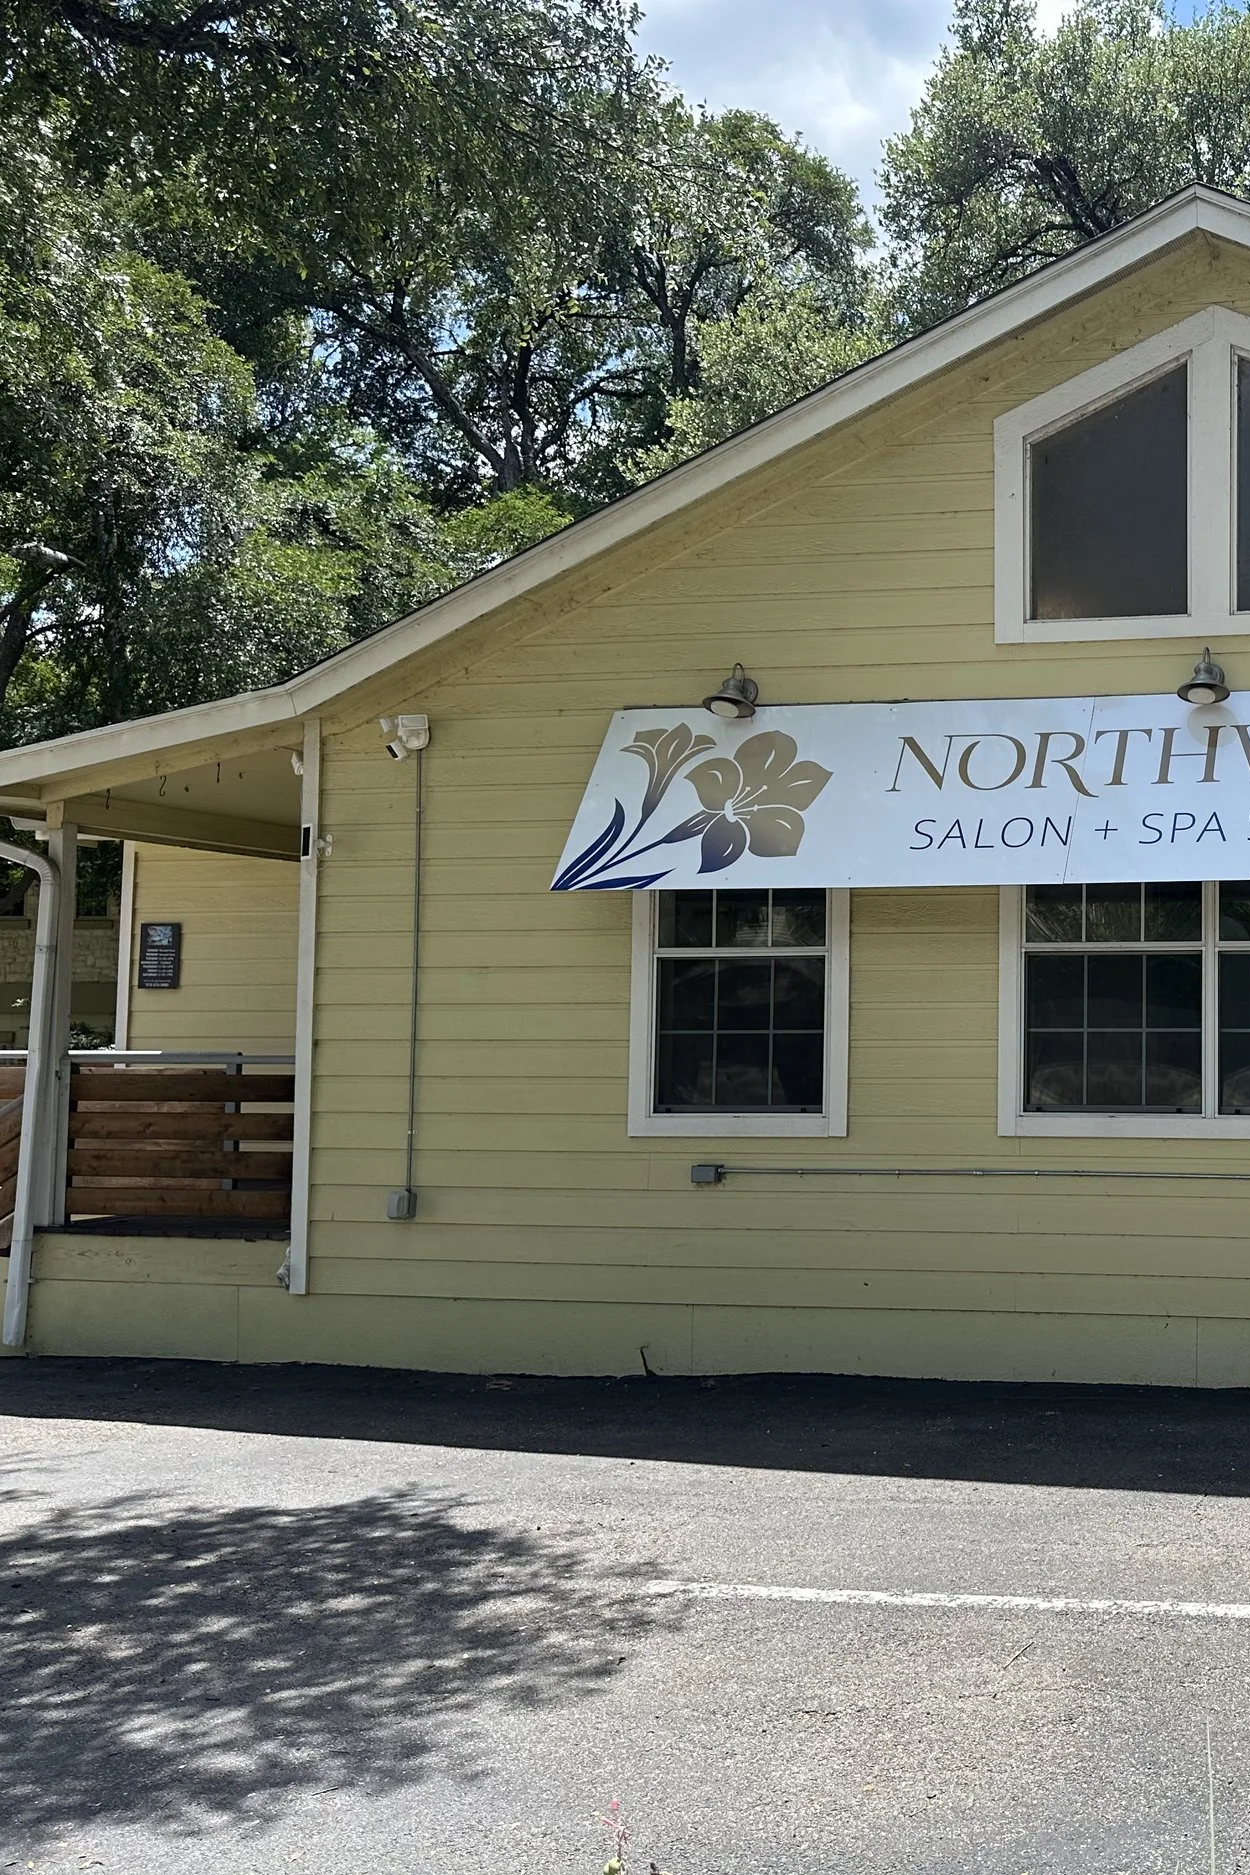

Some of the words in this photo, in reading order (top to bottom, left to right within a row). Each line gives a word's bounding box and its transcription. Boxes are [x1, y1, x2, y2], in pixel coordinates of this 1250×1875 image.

[909, 815, 1073, 850] SALON
[1094, 819, 1119, 841] +
[1138, 811, 1227, 845] SPA
